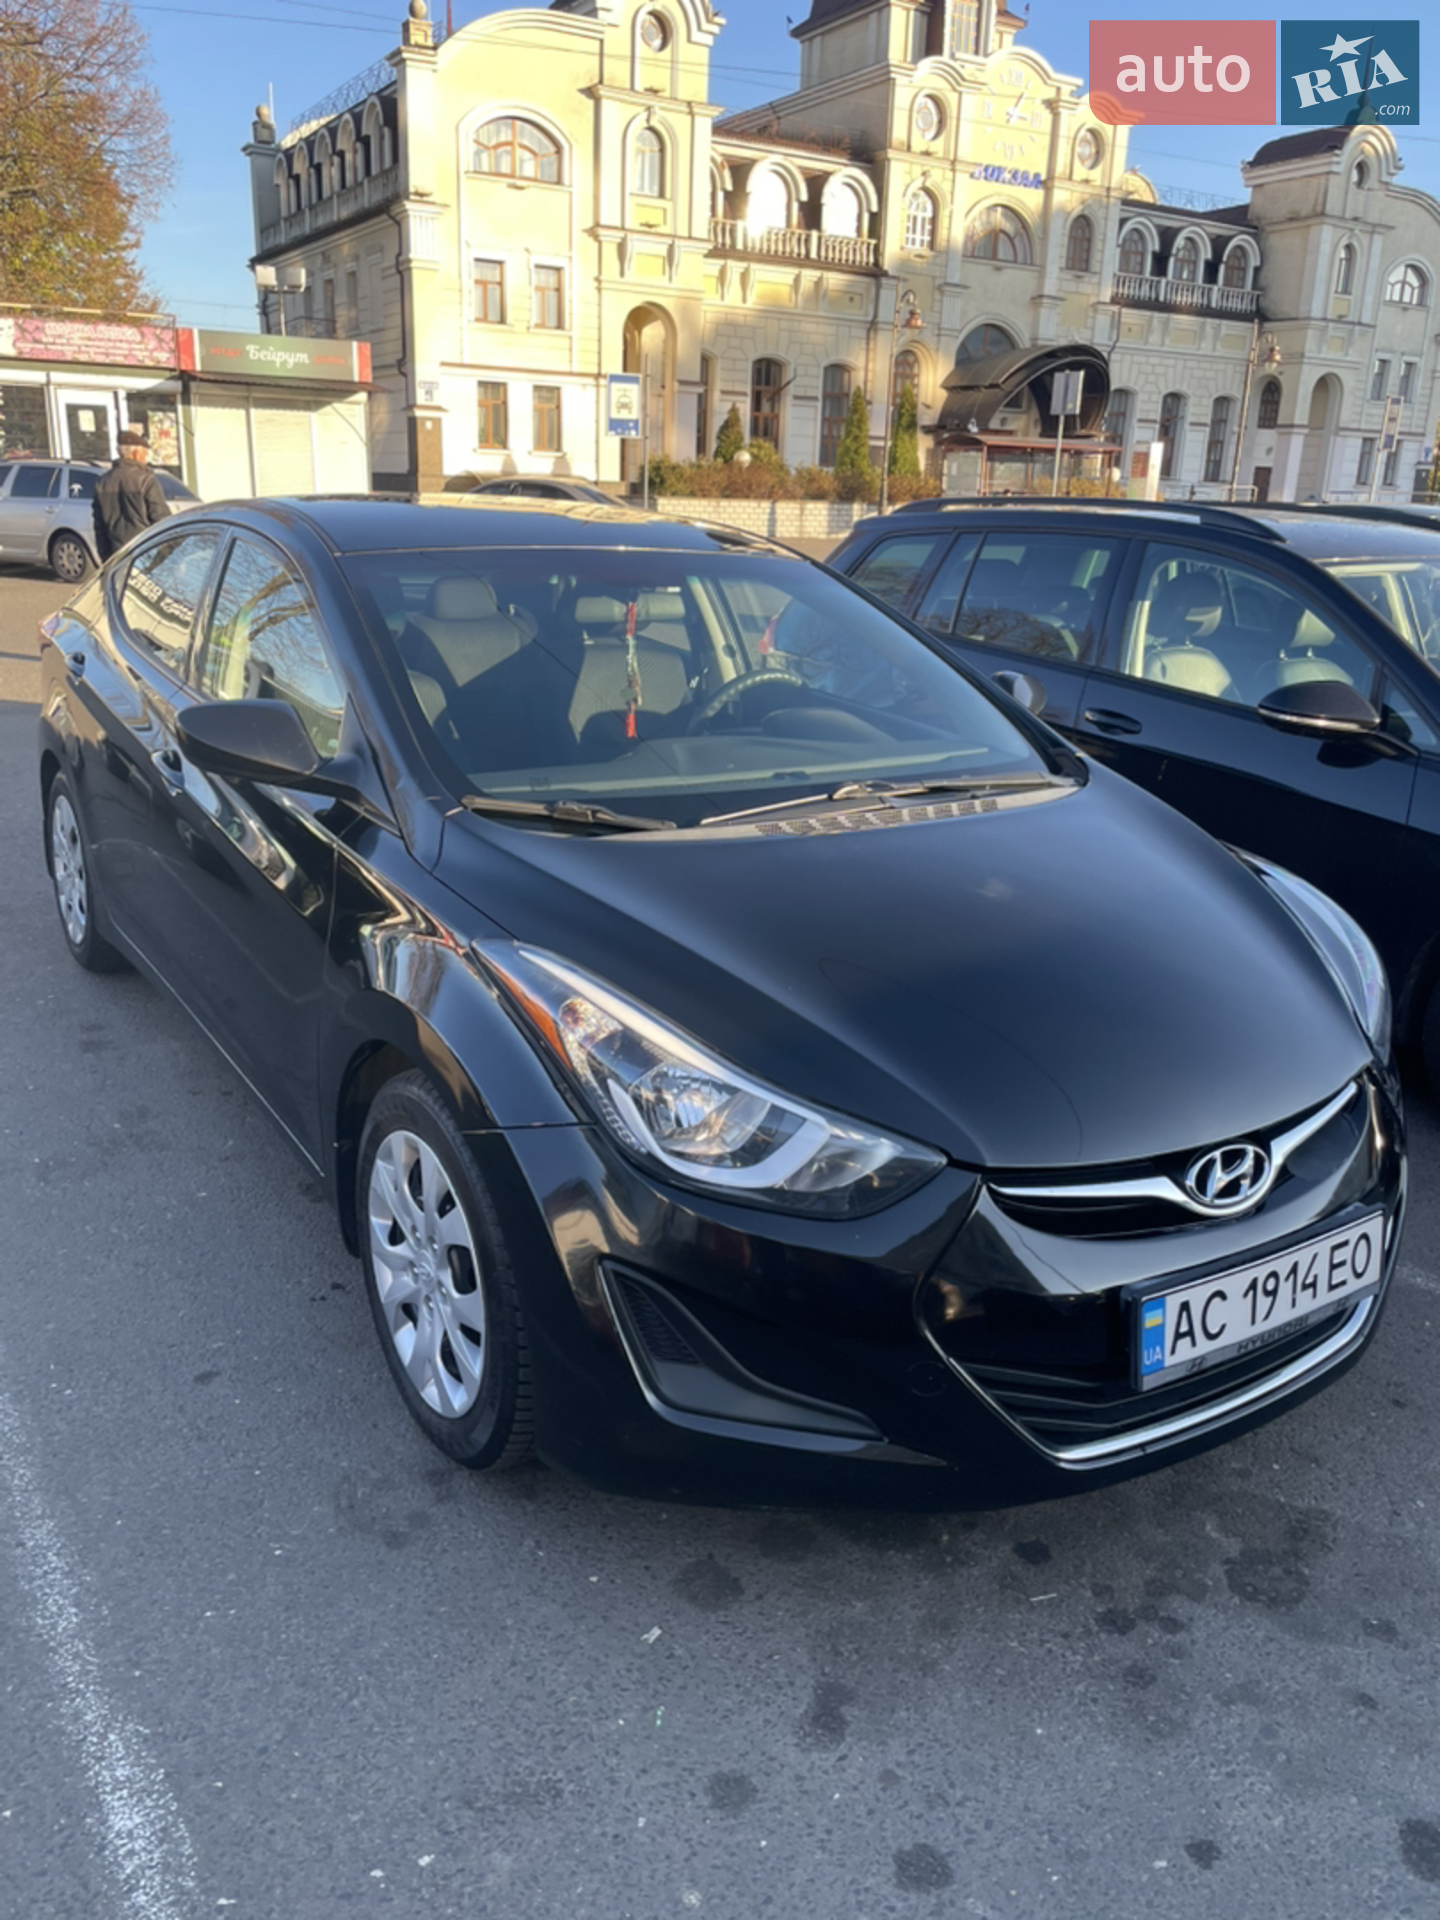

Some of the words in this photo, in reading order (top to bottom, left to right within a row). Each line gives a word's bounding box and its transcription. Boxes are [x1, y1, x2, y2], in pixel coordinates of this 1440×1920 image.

[245, 345, 310, 368] Бейрут
[1170, 1290, 1227, 1356] AC
[1243, 1252, 1318, 1326] 1914
[1328, 1232, 1372, 1292] EO
[1144, 1344, 1162, 1365] UA
